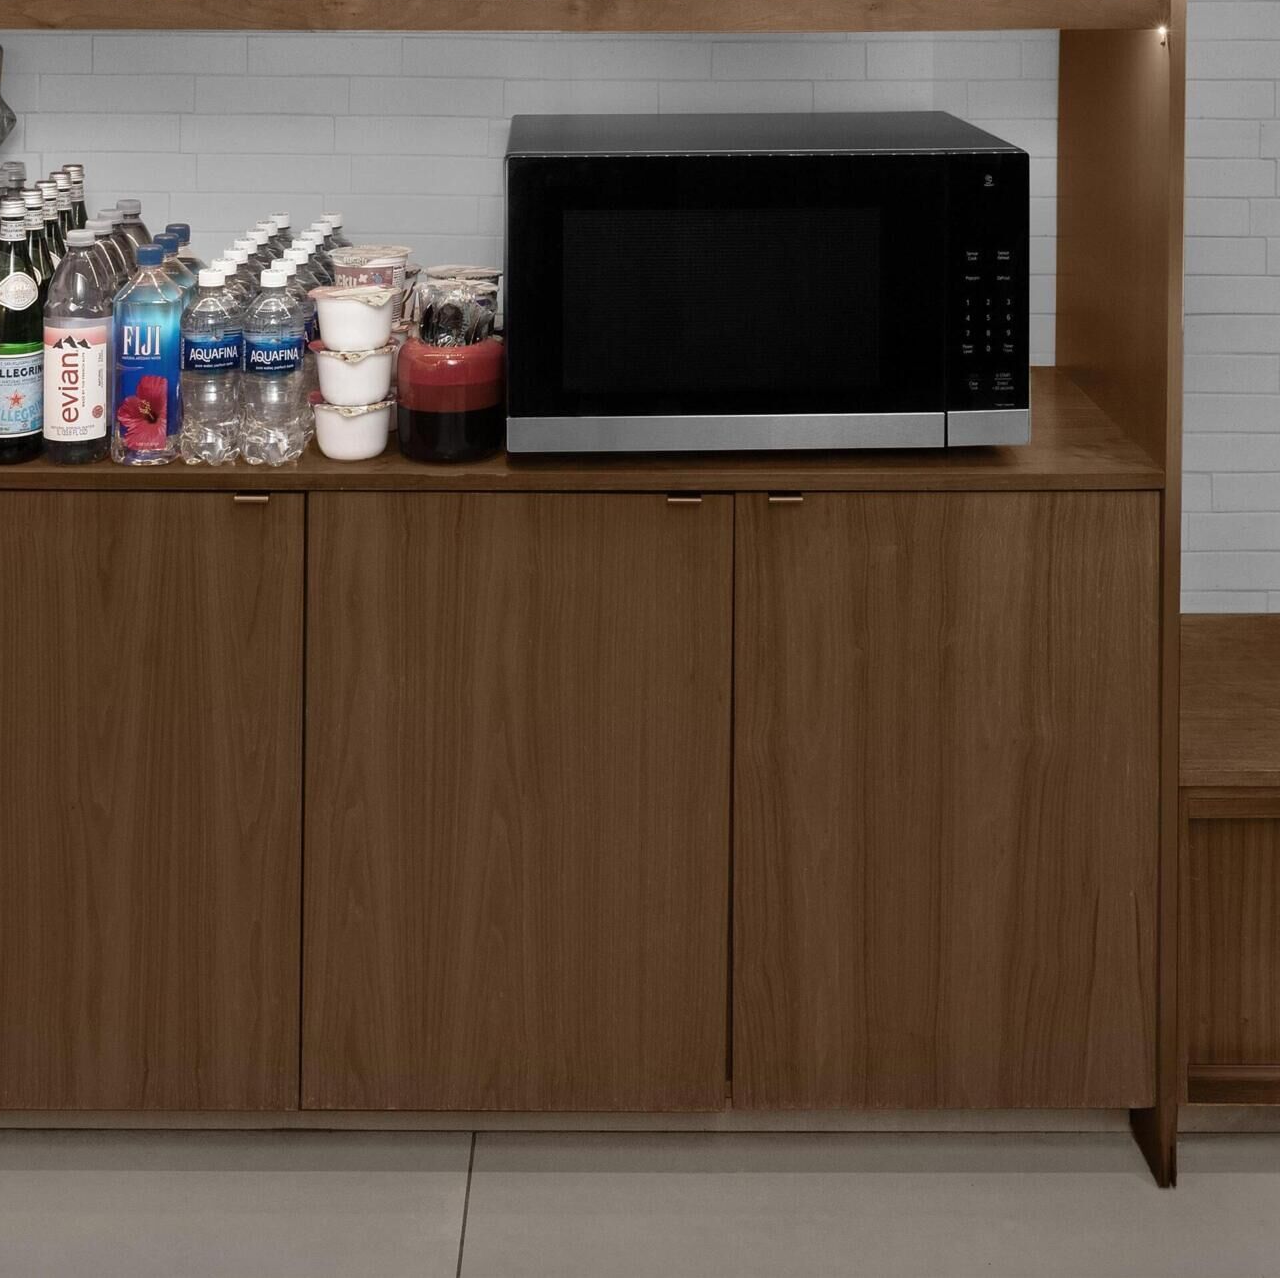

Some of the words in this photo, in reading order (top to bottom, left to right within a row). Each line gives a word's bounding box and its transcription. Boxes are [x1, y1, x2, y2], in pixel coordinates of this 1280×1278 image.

[123, 325, 161, 356] FIJI
[190, 345, 238, 362] AQUAFINA
[250, 348, 299, 365] AQUAFINA
[60, 352, 79, 423] evian
